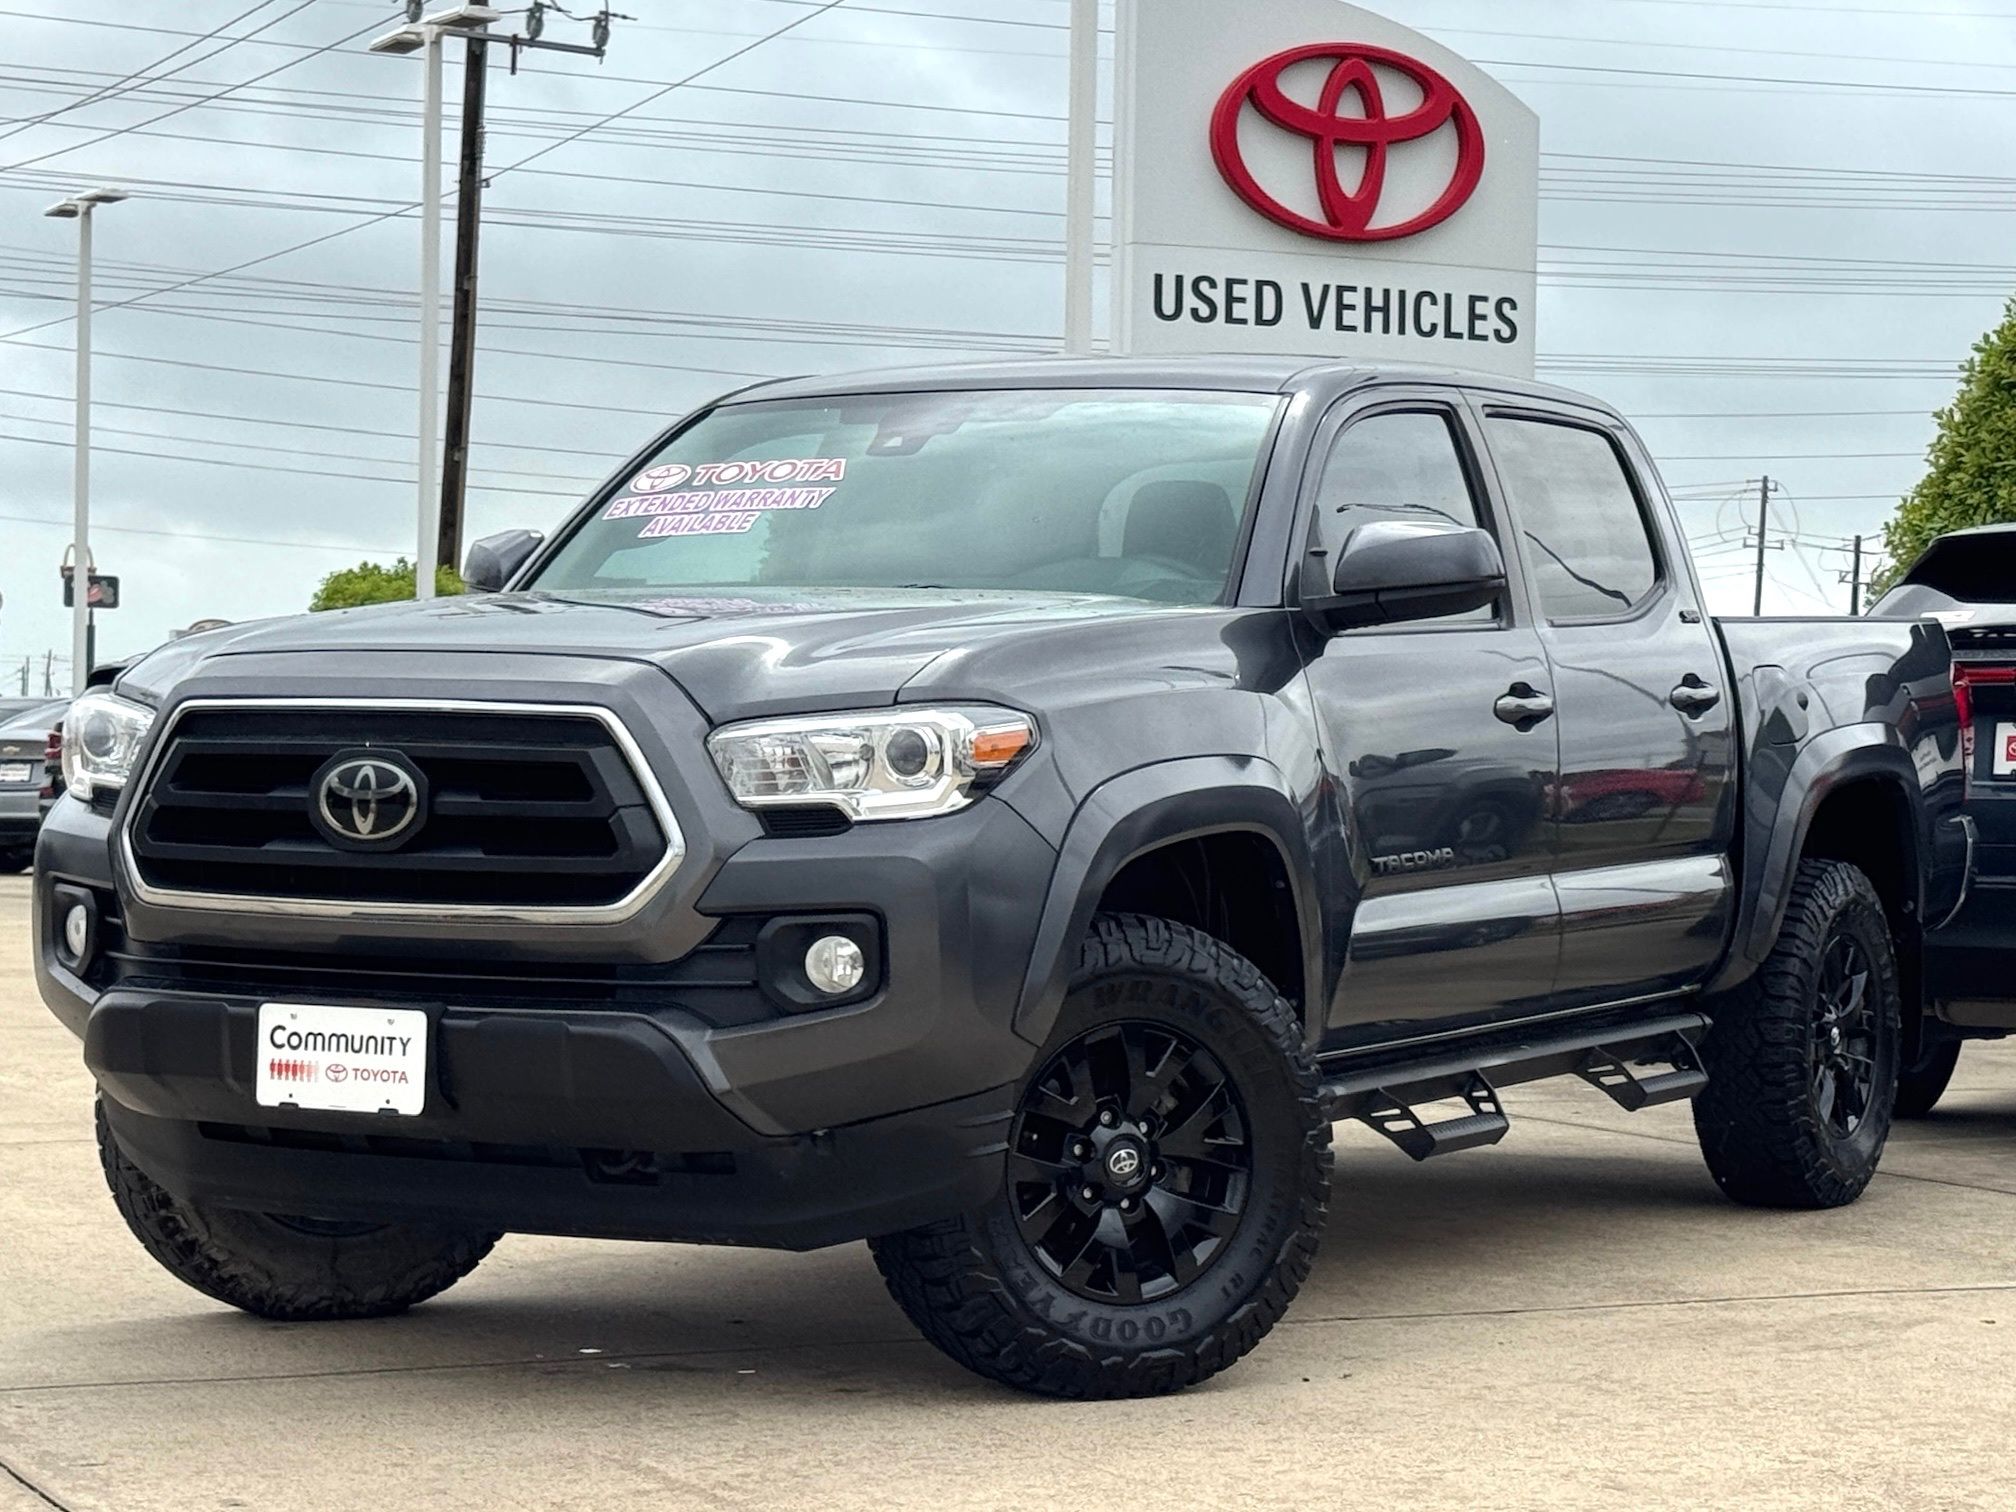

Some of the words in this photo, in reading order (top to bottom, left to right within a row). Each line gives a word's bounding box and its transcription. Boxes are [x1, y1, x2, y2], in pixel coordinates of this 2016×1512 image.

[1153, 273, 1283, 327] USED
[1300, 282, 1518, 344] VEHICLES
[693, 460, 844, 483] TOYOTA
[606, 491, 710, 519] EXTENDED
[712, 488, 832, 510] WARRANTY
[642, 512, 757, 535] AVAILABLE
[1371, 847, 1454, 873] TACOMA
[352, 1068, 408, 1083] TOYOTA
